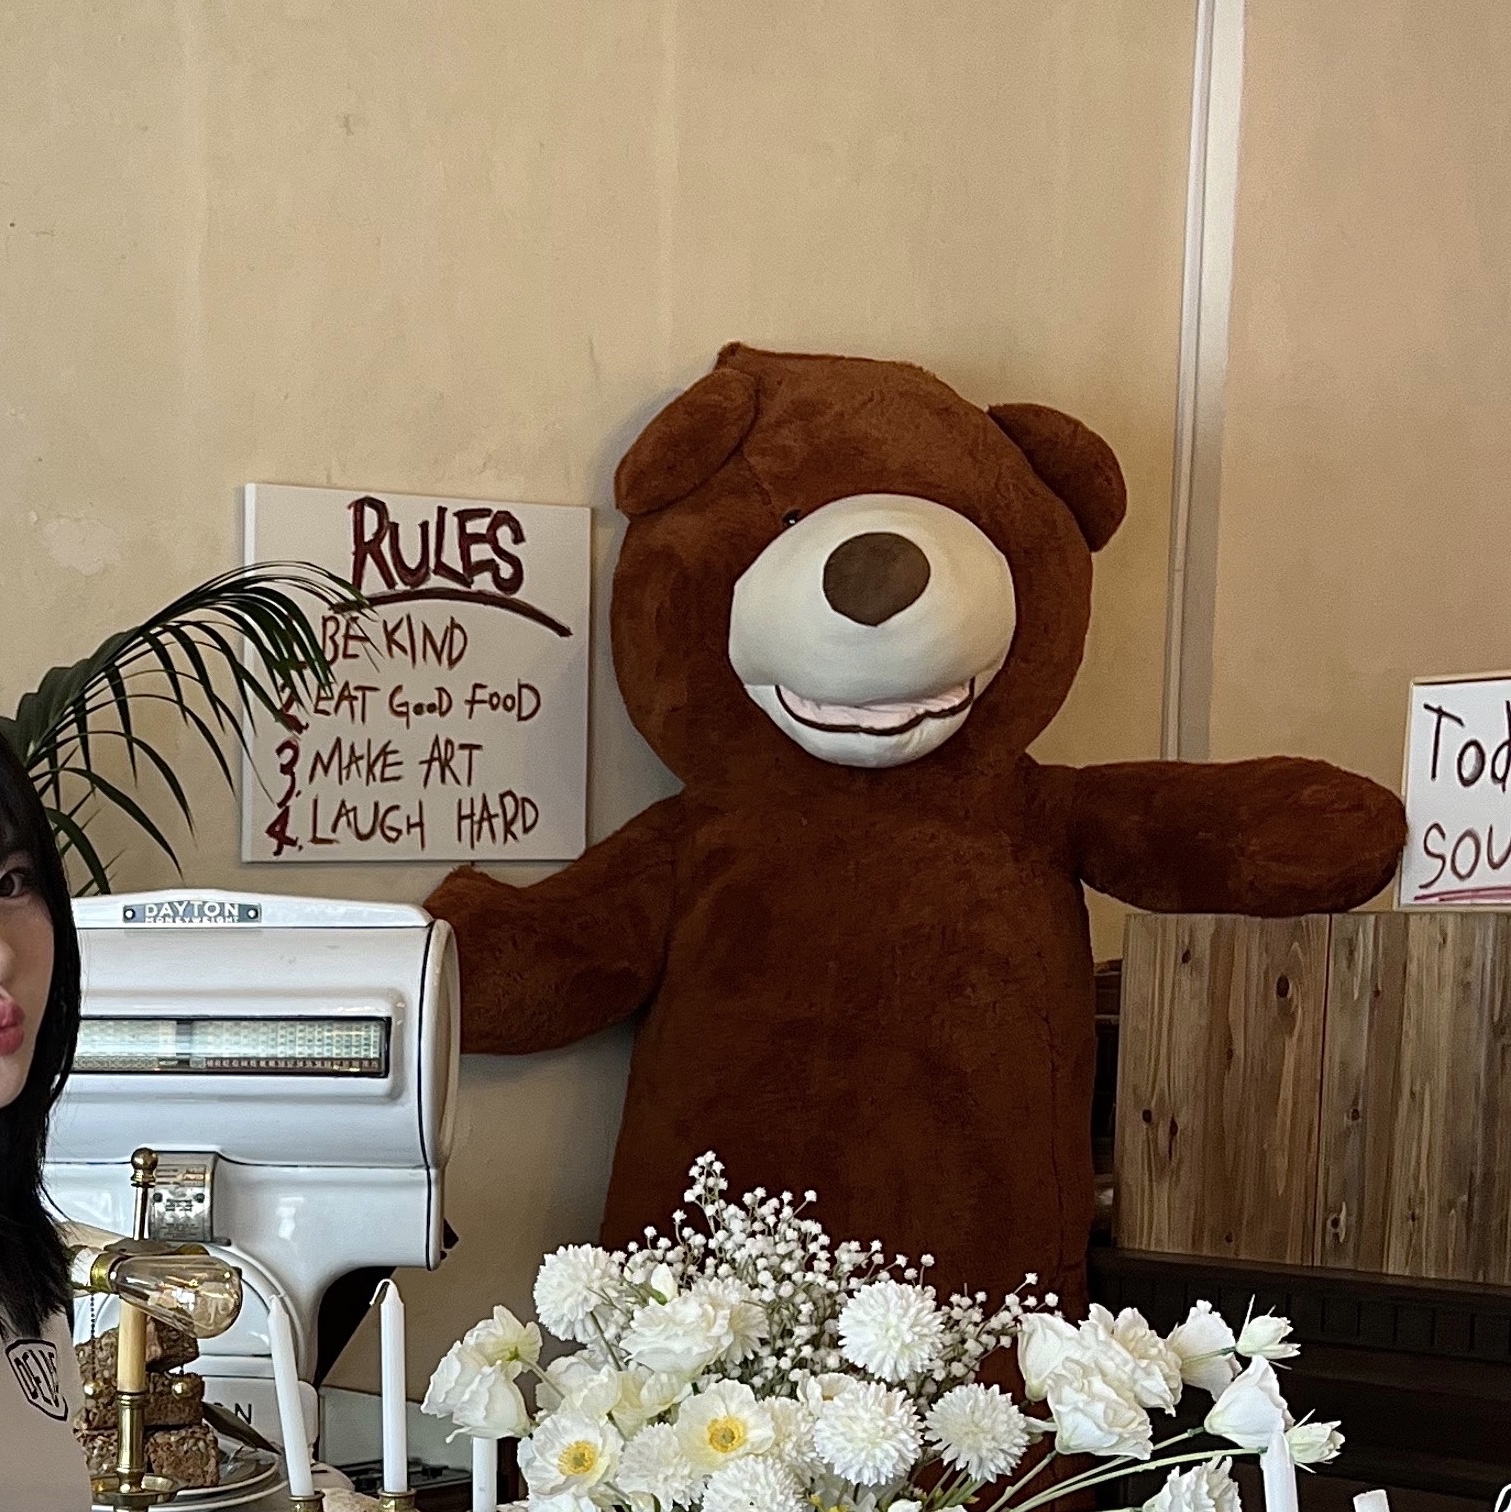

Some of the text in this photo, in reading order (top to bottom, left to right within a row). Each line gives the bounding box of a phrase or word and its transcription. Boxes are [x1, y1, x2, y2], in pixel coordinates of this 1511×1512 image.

[347, 495, 527, 597] RULES
[320, 611, 468, 671] BE KIND
[313, 680, 381, 725] EAT
[308, 735, 403, 789] MAKE
[418, 733, 483, 790] ART
[307, 793, 425, 852] LAUGH
[456, 789, 540, 851] HARD
[144, 900, 239, 916] DAYTON
